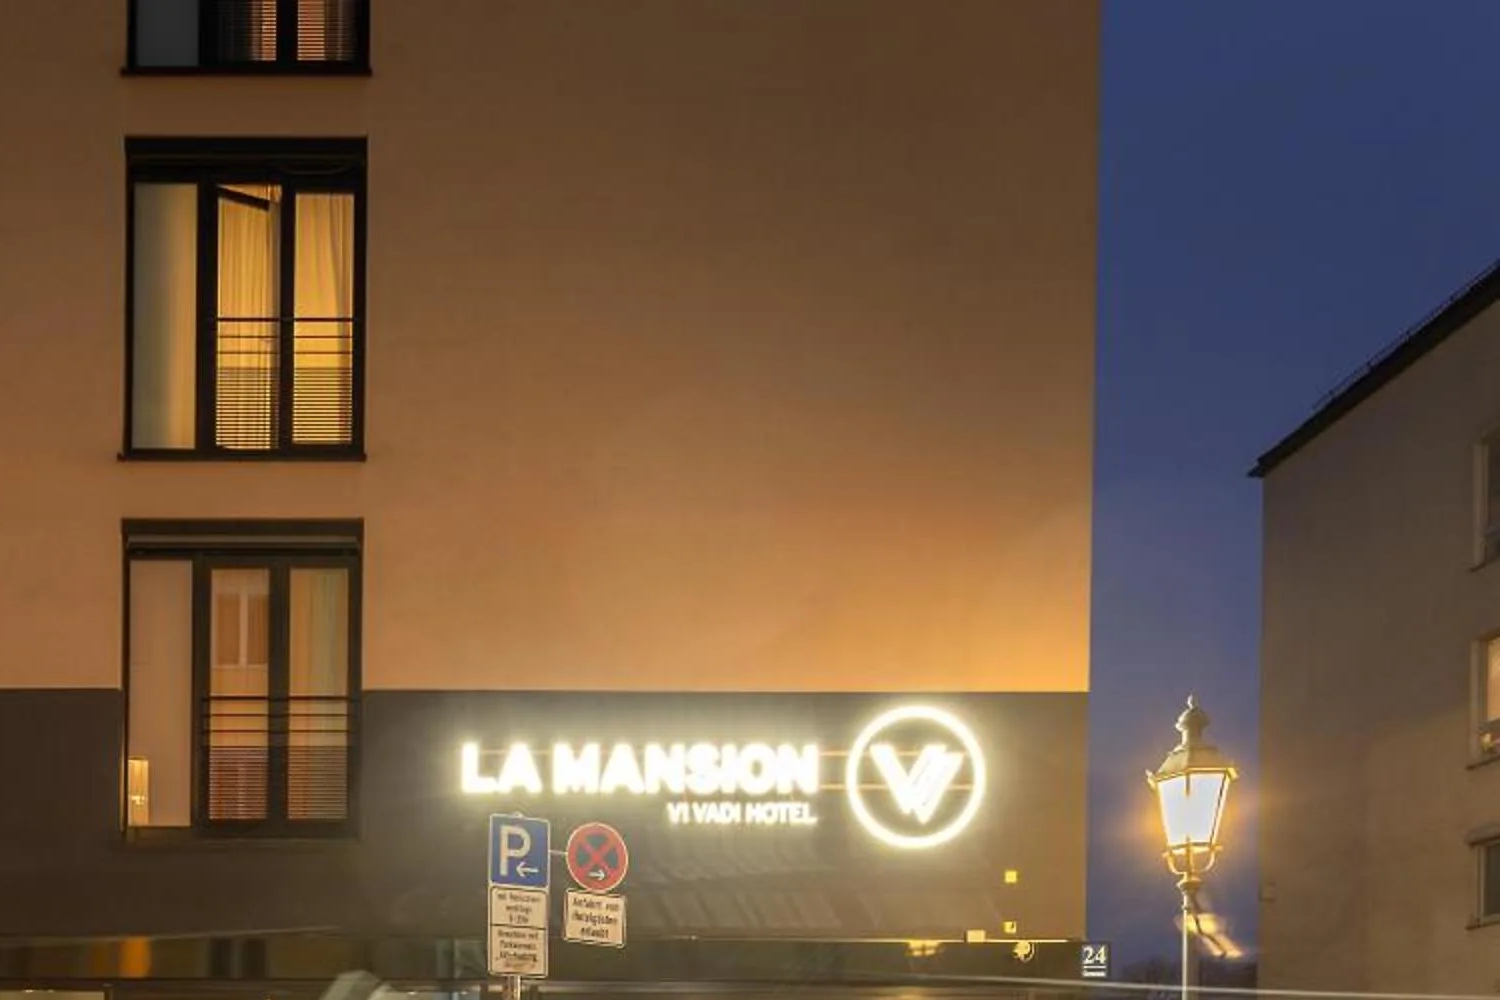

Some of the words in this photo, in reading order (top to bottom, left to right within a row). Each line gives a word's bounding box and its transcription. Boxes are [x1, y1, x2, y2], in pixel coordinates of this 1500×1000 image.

[461, 742, 542, 794] LA
[553, 742, 819, 795] MANSION
[666, 802, 689, 824] VI
[692, 802, 741, 824] VADI
[745, 802, 818, 825] HOTEL
[500, 825, 531, 876] P
[1083, 945, 1106, 964] 24
